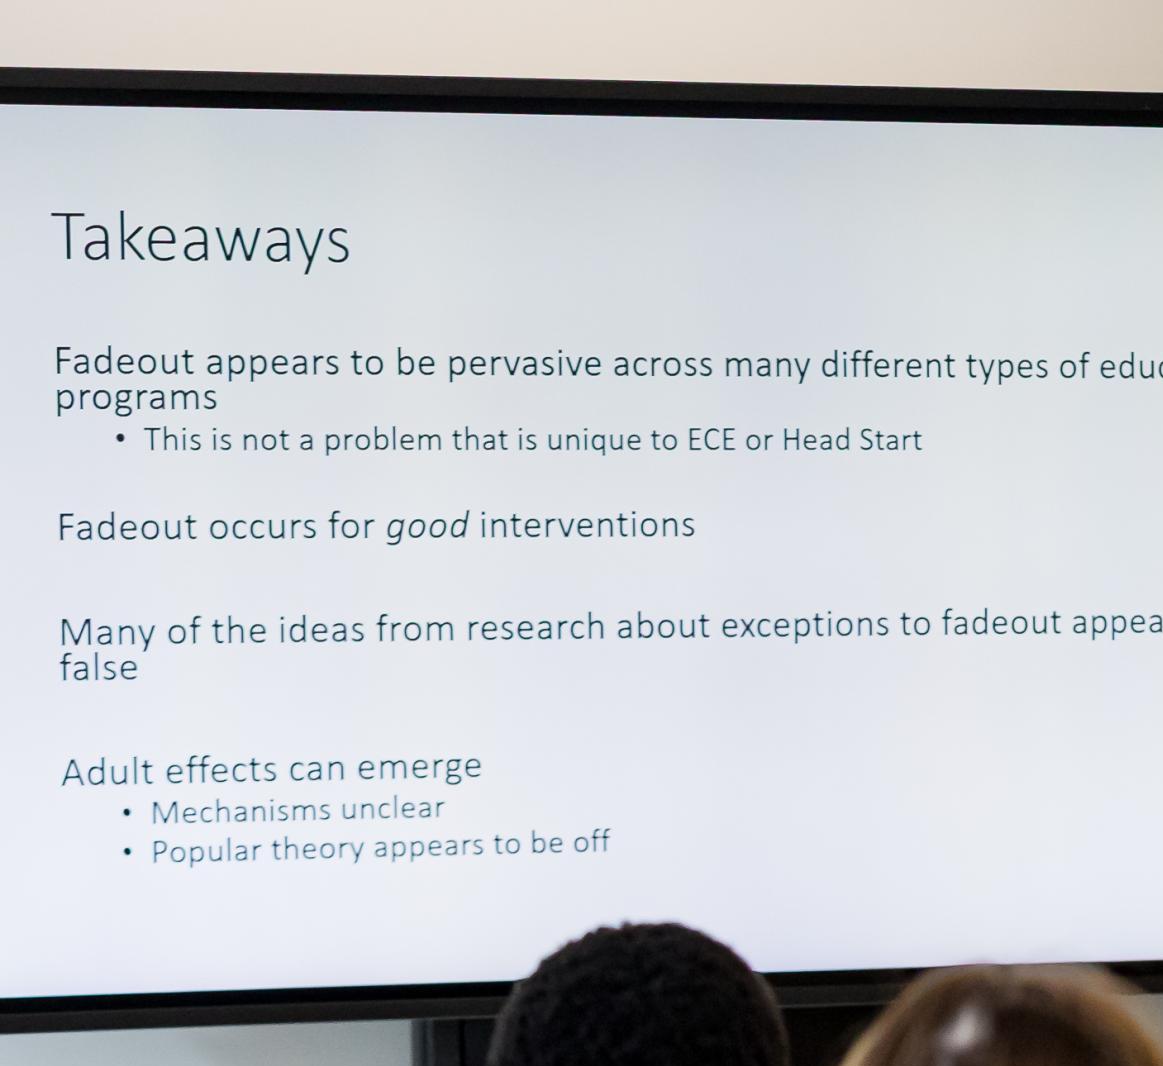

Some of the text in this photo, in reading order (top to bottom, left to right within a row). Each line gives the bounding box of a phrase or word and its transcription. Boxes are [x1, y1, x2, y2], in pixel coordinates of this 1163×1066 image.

[50, 209, 351, 276] Takeaways
[56, 344, 195, 375] Fadeout
[206, 354, 340, 383] appears
[350, 350, 384, 376] to
[396, 346, 436, 376] be
[448, 348, 602, 384] pervasive
[613, 356, 713, 377] across
[724, 357, 812, 385] many
[821, 349, 957, 379] different
[966, 353, 1049, 385] types
[1059, 350, 1091, 380] of
[56, 388, 218, 418] programs
[143, 425, 923, 457] This is not a problem that is unique to ECE or Head Start
[59, 509, 696, 547] Fadeout occurs for good interventions
[60, 617, 156, 652] Many
[167, 614, 203, 645] of
[211, 614, 267, 644] the
[279, 614, 365, 644] ideas
[375, 613, 454, 643] from
[467, 610, 605, 641] research
[617, 610, 711, 640] about
[721, 610, 890, 645] exceptions
[899, 611, 932, 637] to
[941, 607, 1062, 636] fadeout
[59, 652, 138, 682] false
[61, 754, 482, 787] Adult effects can emerge
[152, 794, 446, 825] Mechanisms unclear
[152, 828, 611, 869] Popular theory appears to be off
